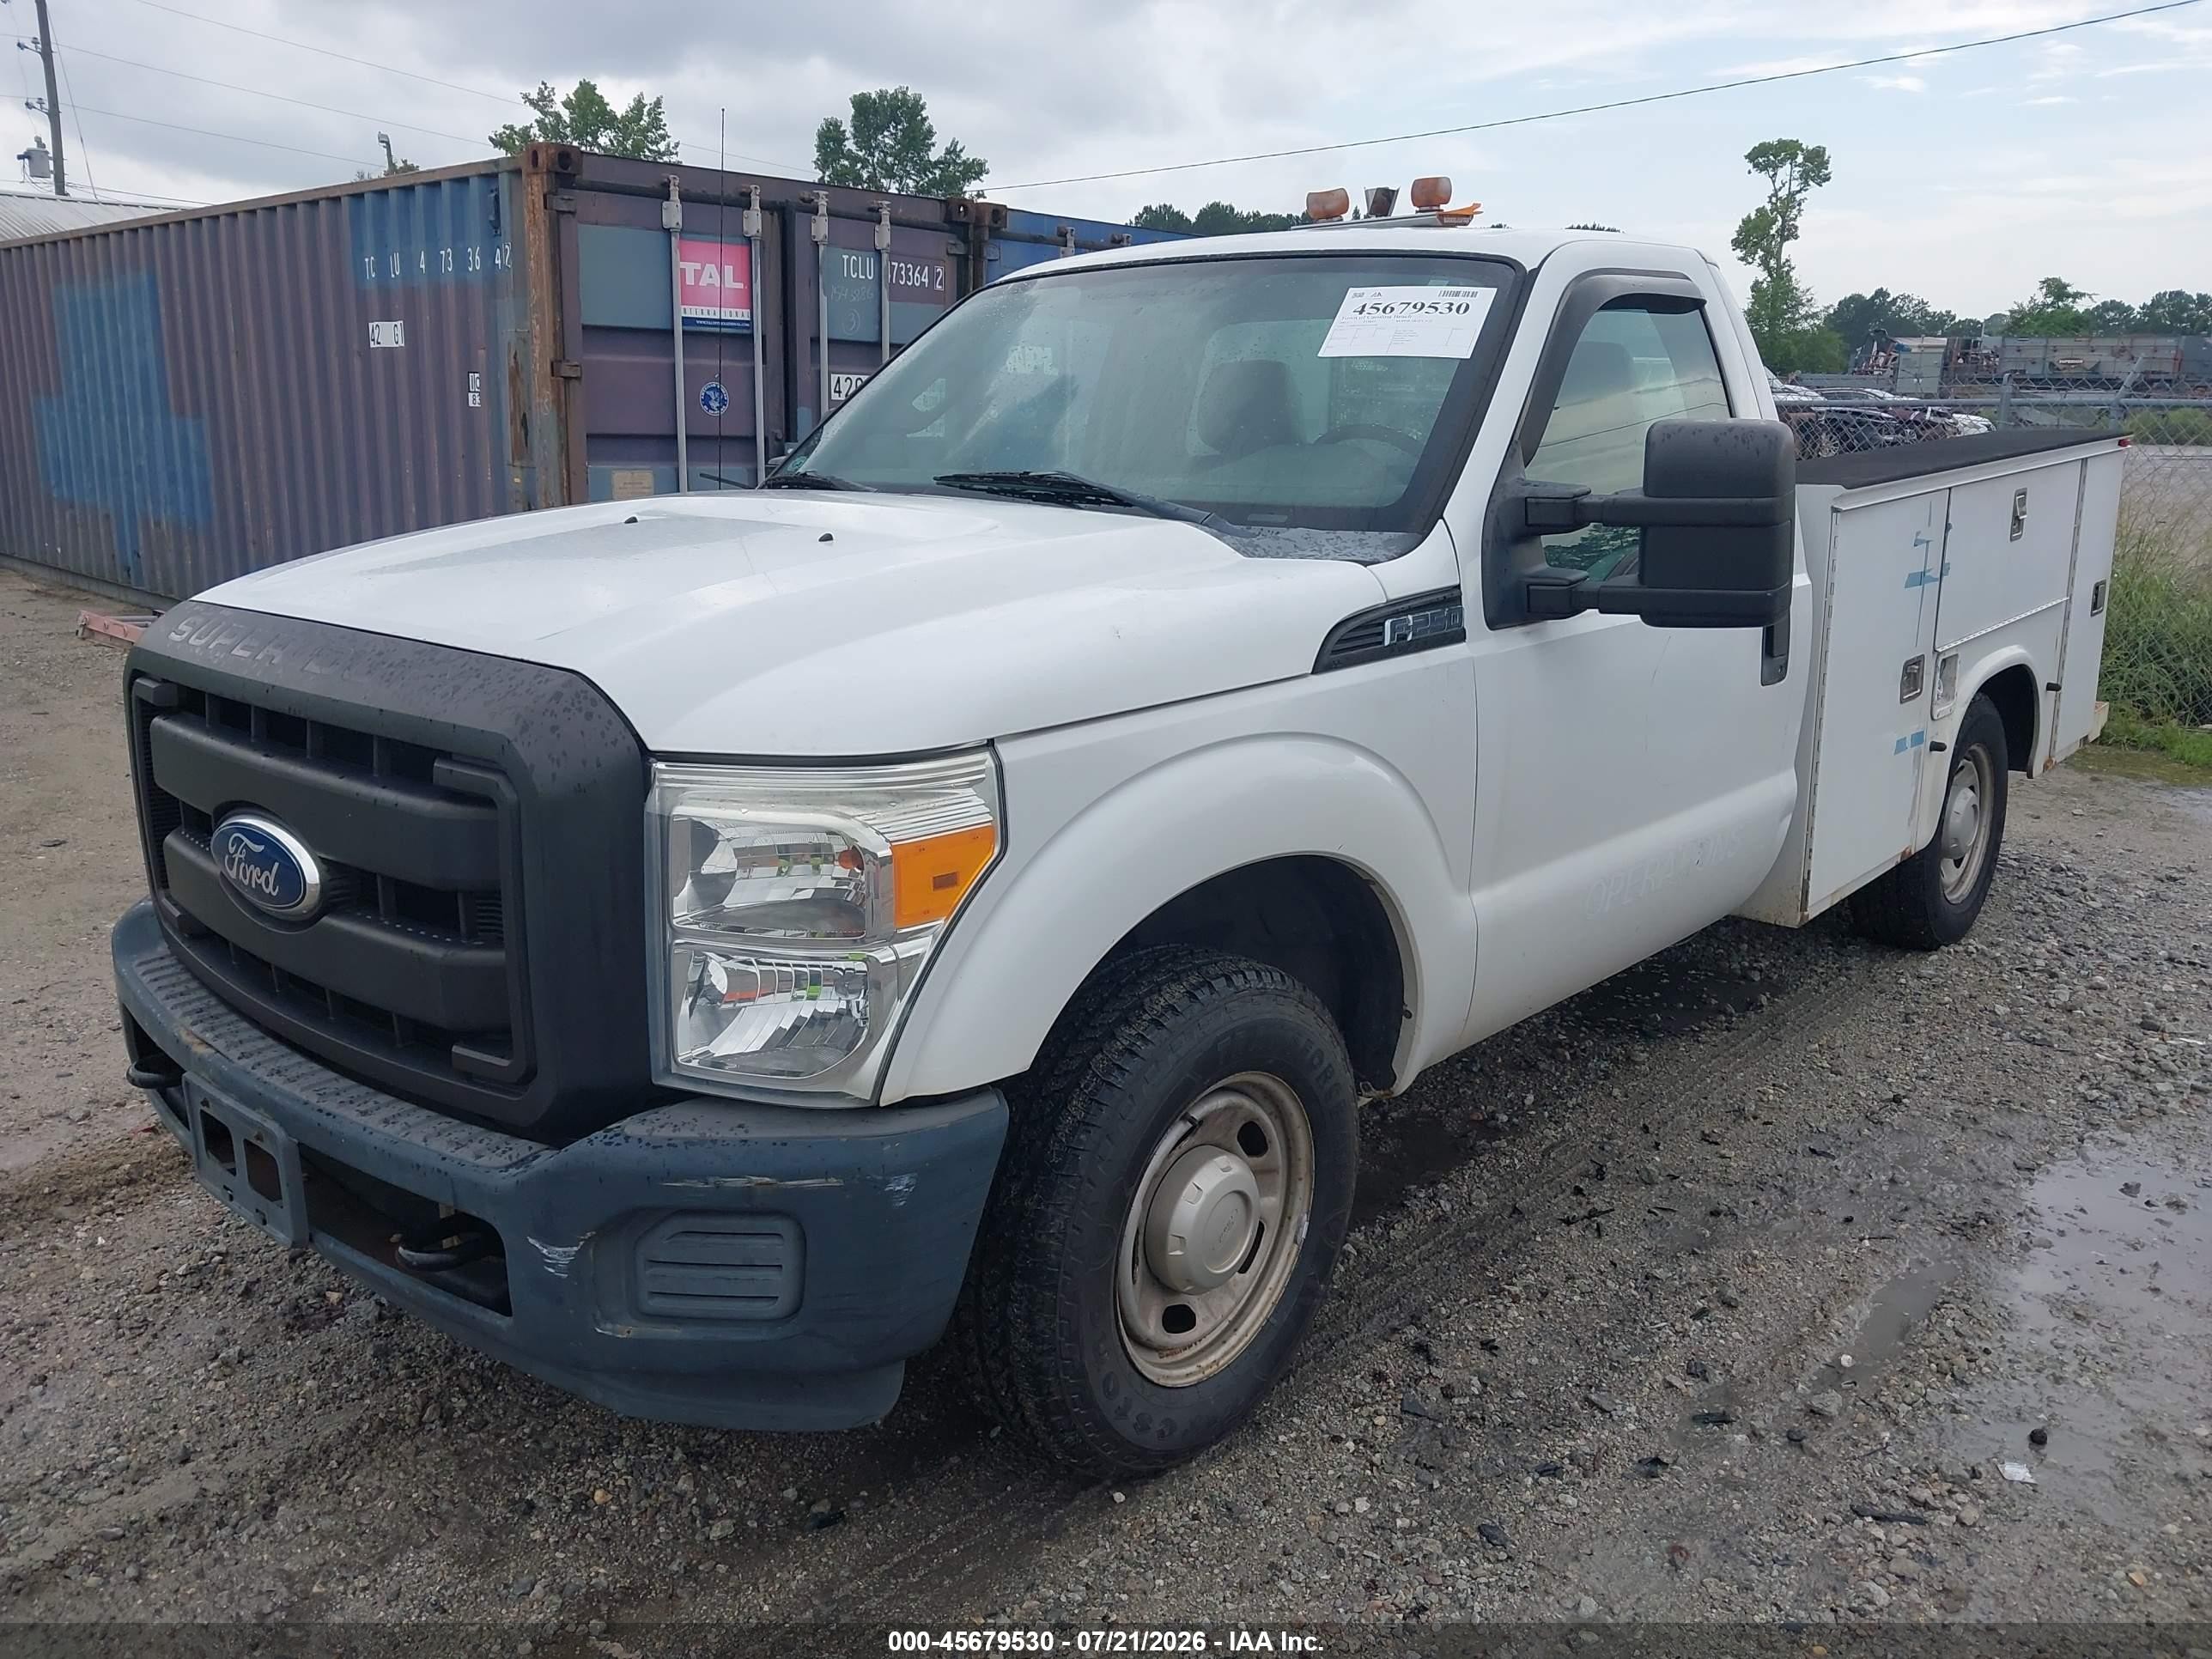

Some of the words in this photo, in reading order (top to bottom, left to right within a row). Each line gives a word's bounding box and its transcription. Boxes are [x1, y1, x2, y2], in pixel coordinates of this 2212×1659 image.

[680, 261, 744, 289] TAL
[842, 254, 874, 280] TCLU
[888, 260, 929, 289] 73364
[1352, 301, 1470, 316] 45679530
[167, 615, 283, 666] SUPER
[224, 832, 280, 897] Ford
